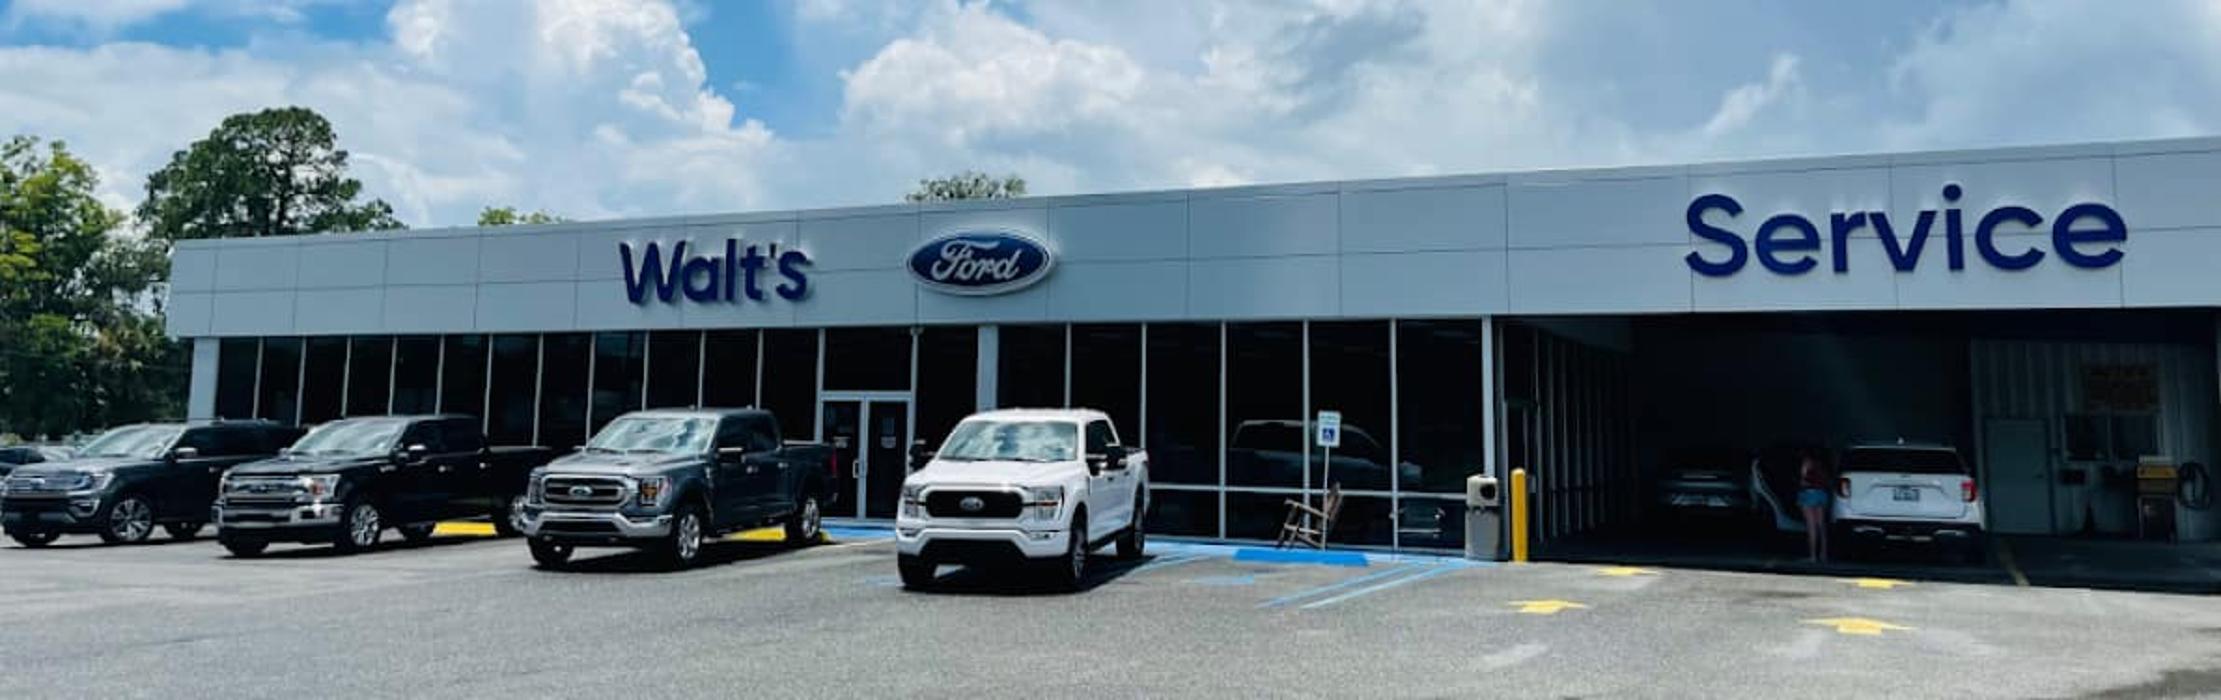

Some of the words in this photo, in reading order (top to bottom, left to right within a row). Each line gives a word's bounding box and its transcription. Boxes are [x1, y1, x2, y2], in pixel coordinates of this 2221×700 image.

[930, 239, 1022, 281] Ford
[1685, 184, 2127, 277] Service
[619, 238, 812, 304] Walt's
